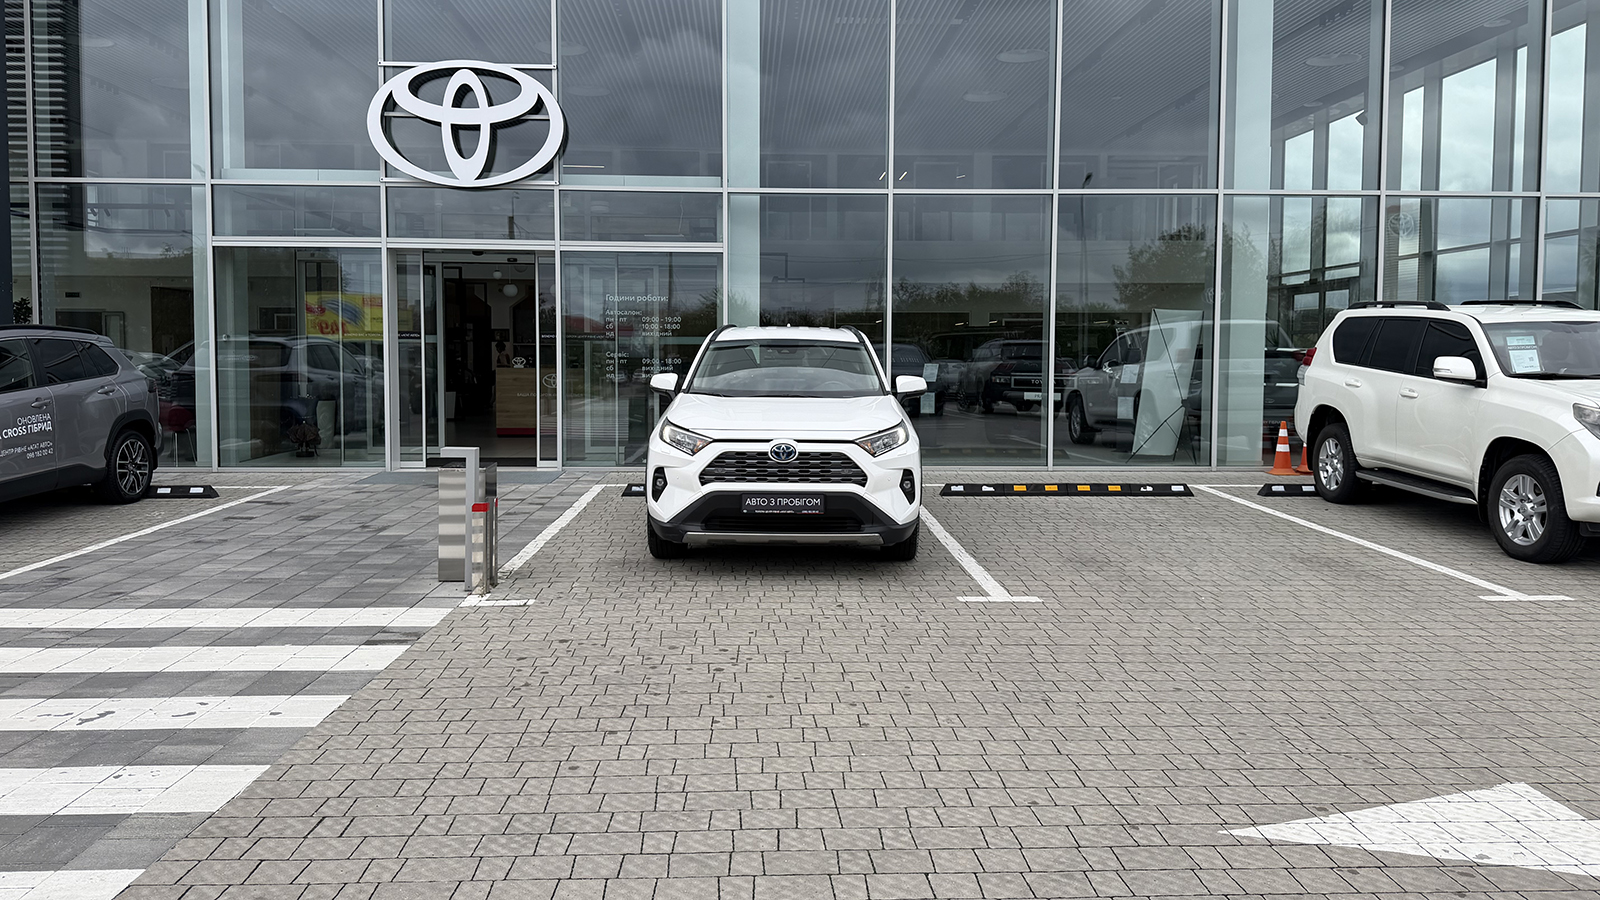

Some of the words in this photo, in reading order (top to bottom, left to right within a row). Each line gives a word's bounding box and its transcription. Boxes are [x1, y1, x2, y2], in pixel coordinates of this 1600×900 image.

[605, 294, 635, 302] Години
[637, 294, 668, 302] роботи:
[17, 413, 51, 425] ОНОВЛЕНА
[2, 426, 26, 438] CROSS
[745, 498, 768, 506] АВТО
[777, 498, 820, 506] ПРОБІГОМ
